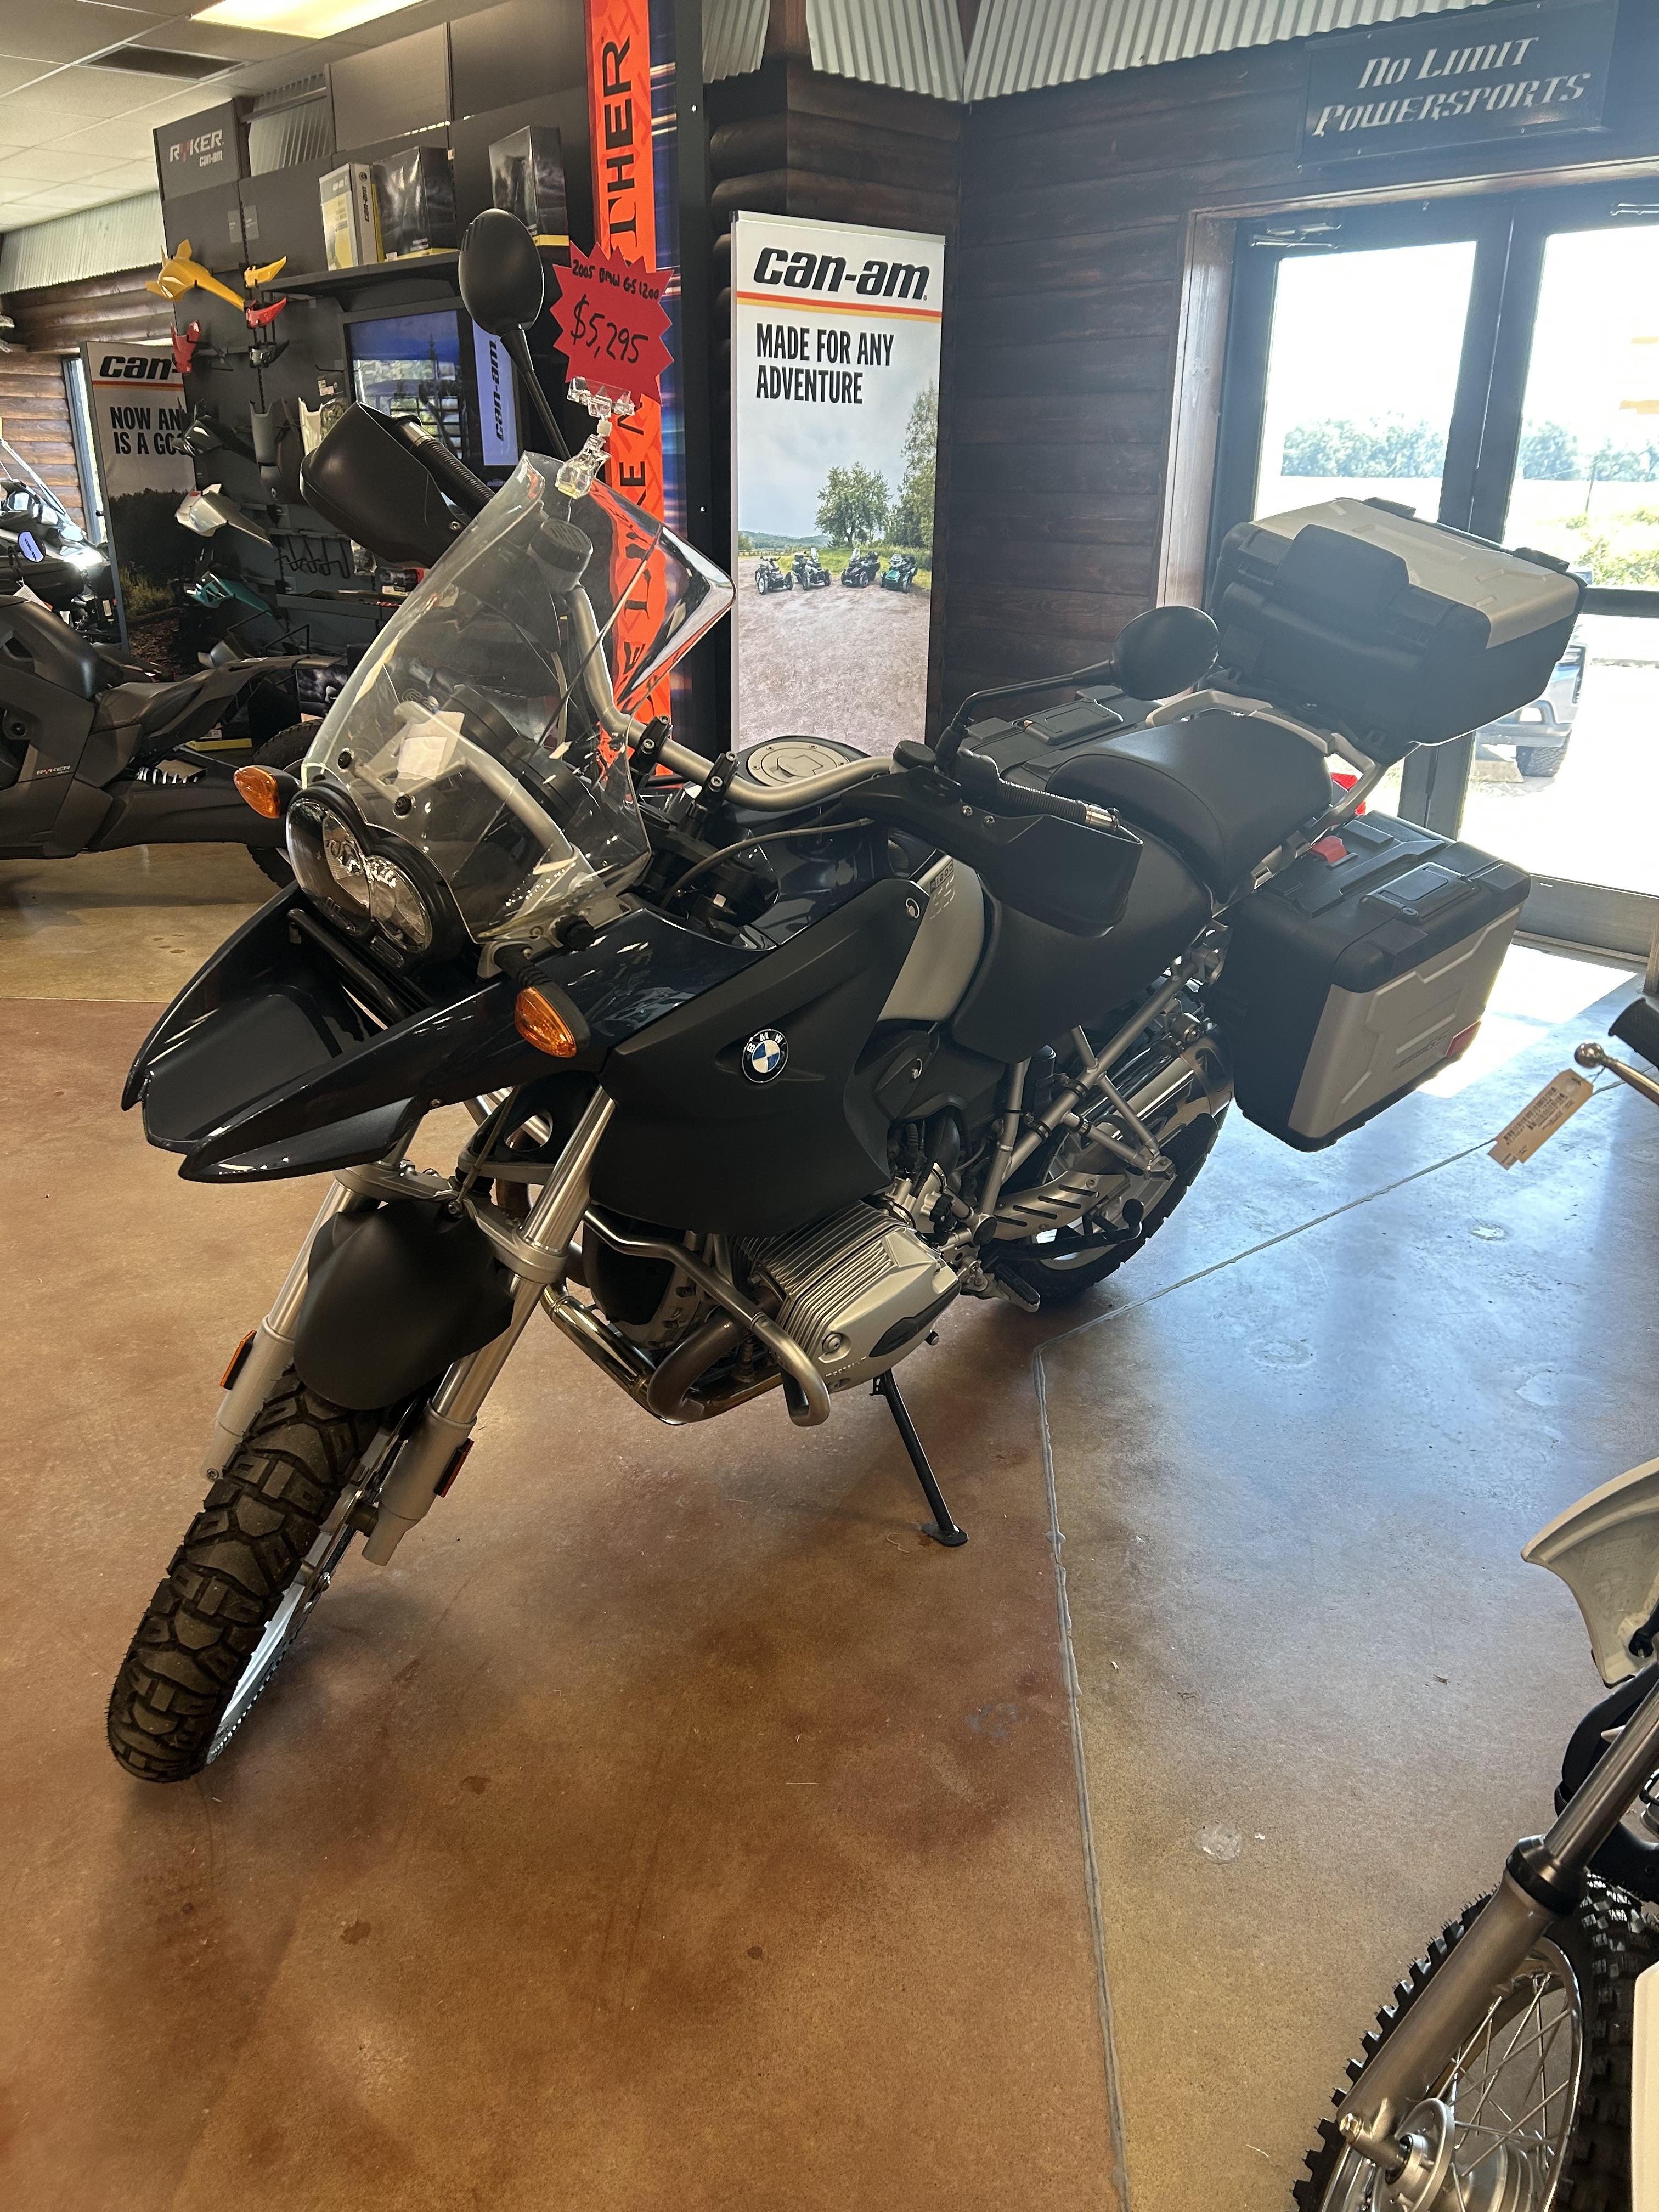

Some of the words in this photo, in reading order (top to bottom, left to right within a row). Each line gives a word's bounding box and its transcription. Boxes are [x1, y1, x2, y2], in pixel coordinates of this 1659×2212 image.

[1311, 72, 1591, 137] POWERSPORTS
[170, 129, 223, 163] RYKER
[199, 150, 223, 167] can-am
[602, 35, 638, 267] THER
[572, 259, 596, 279] 2005
[639, 281, 659, 300] 1200
[753, 247, 931, 301] can-am
[570, 293, 649, 364] $5,295
[757, 323, 810, 362] MADE
[817, 329, 851, 364] FOR
[857, 332, 894, 366] ANY
[489, 340, 504, 442] can-am
[756, 364, 864, 404] ADVENTURE
[110, 406, 151, 430] NOW
[114, 431, 132, 454] IS
[138, 432, 149, 454] A
[746, 1032, 783, 1053] BMW
